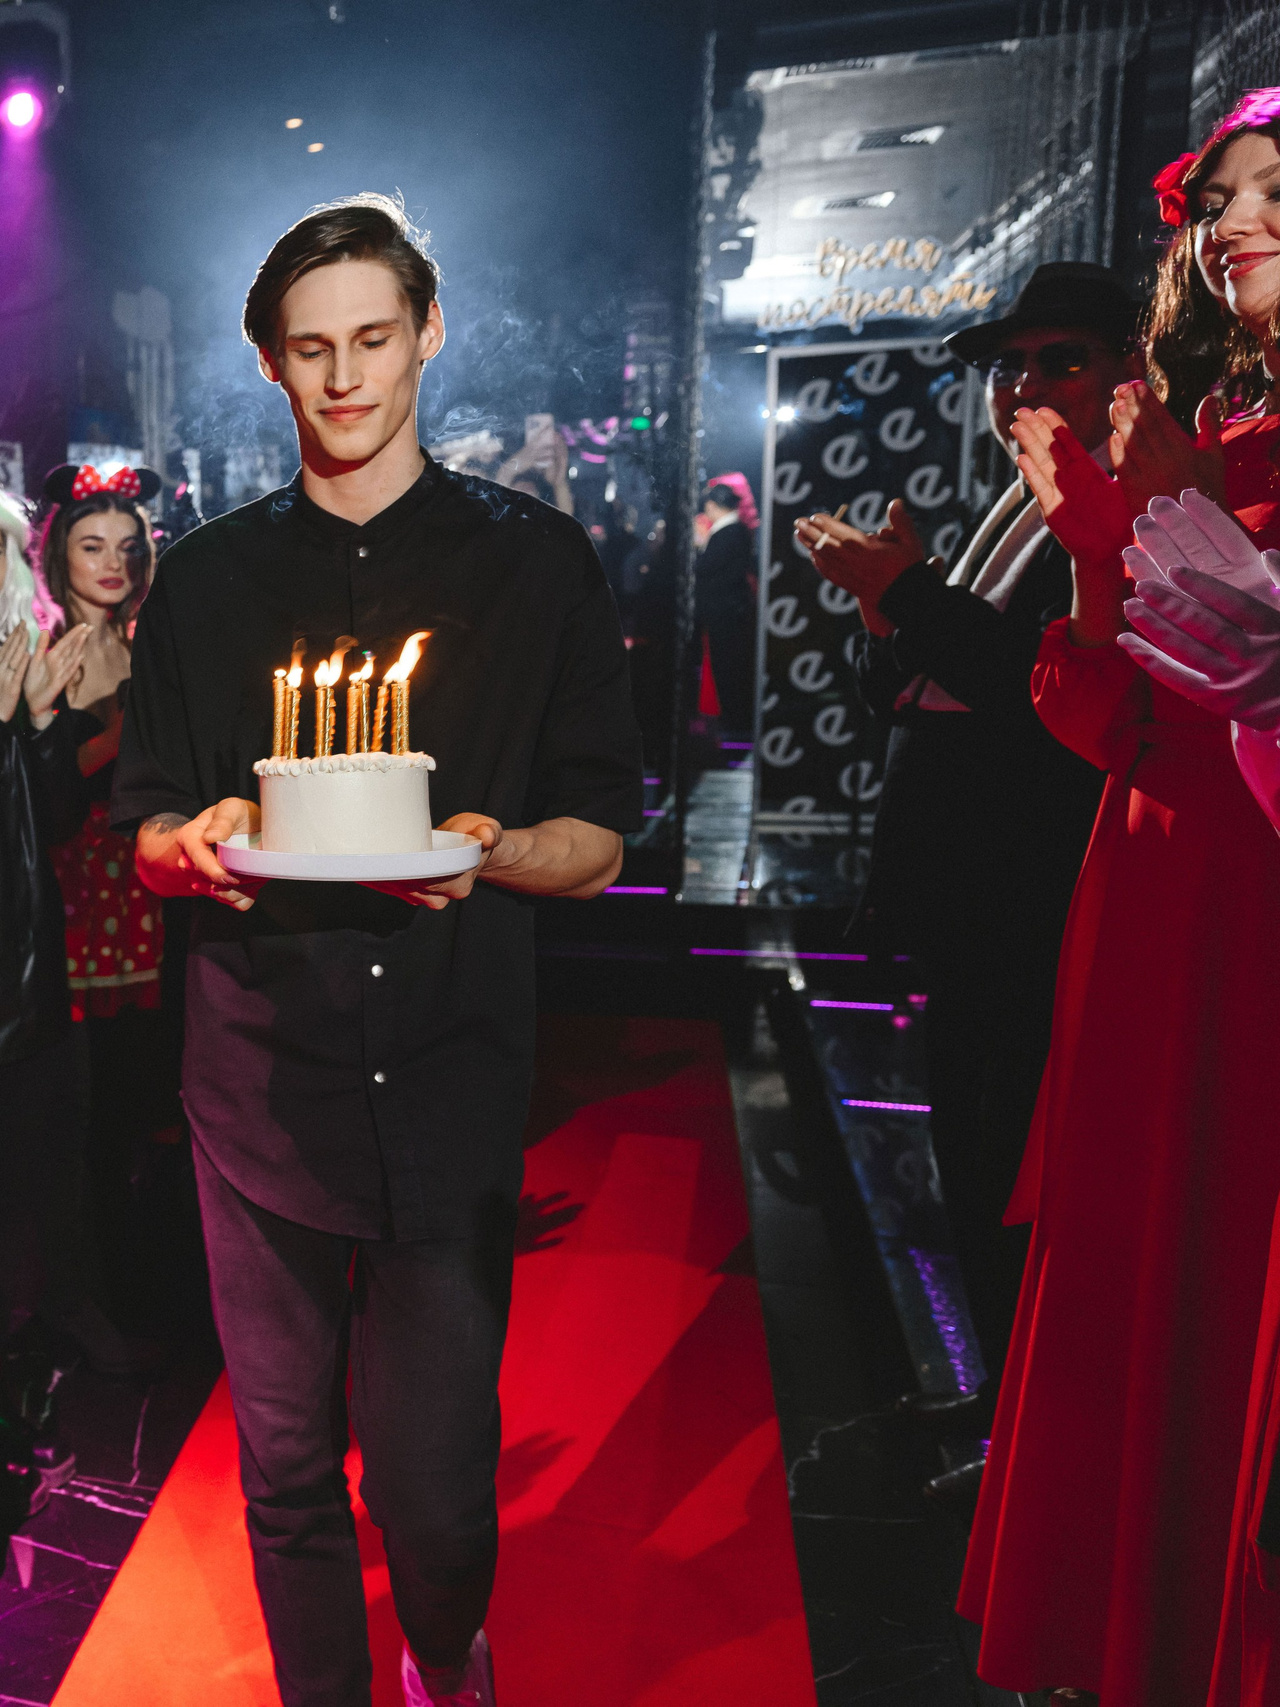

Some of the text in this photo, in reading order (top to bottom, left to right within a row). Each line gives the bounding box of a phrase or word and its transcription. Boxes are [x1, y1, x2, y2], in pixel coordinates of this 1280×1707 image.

[853, 351, 900, 395] e
[797, 378, 843, 423] e
[879, 407, 926, 451] e
[822, 434, 869, 479] e
[772, 461, 812, 505] e
[905, 464, 953, 509] e
[765, 595, 809, 639] e
[789, 650, 834, 693] e
[759, 726, 804, 768] e
[813, 704, 856, 747] e
[839, 760, 884, 801] e
